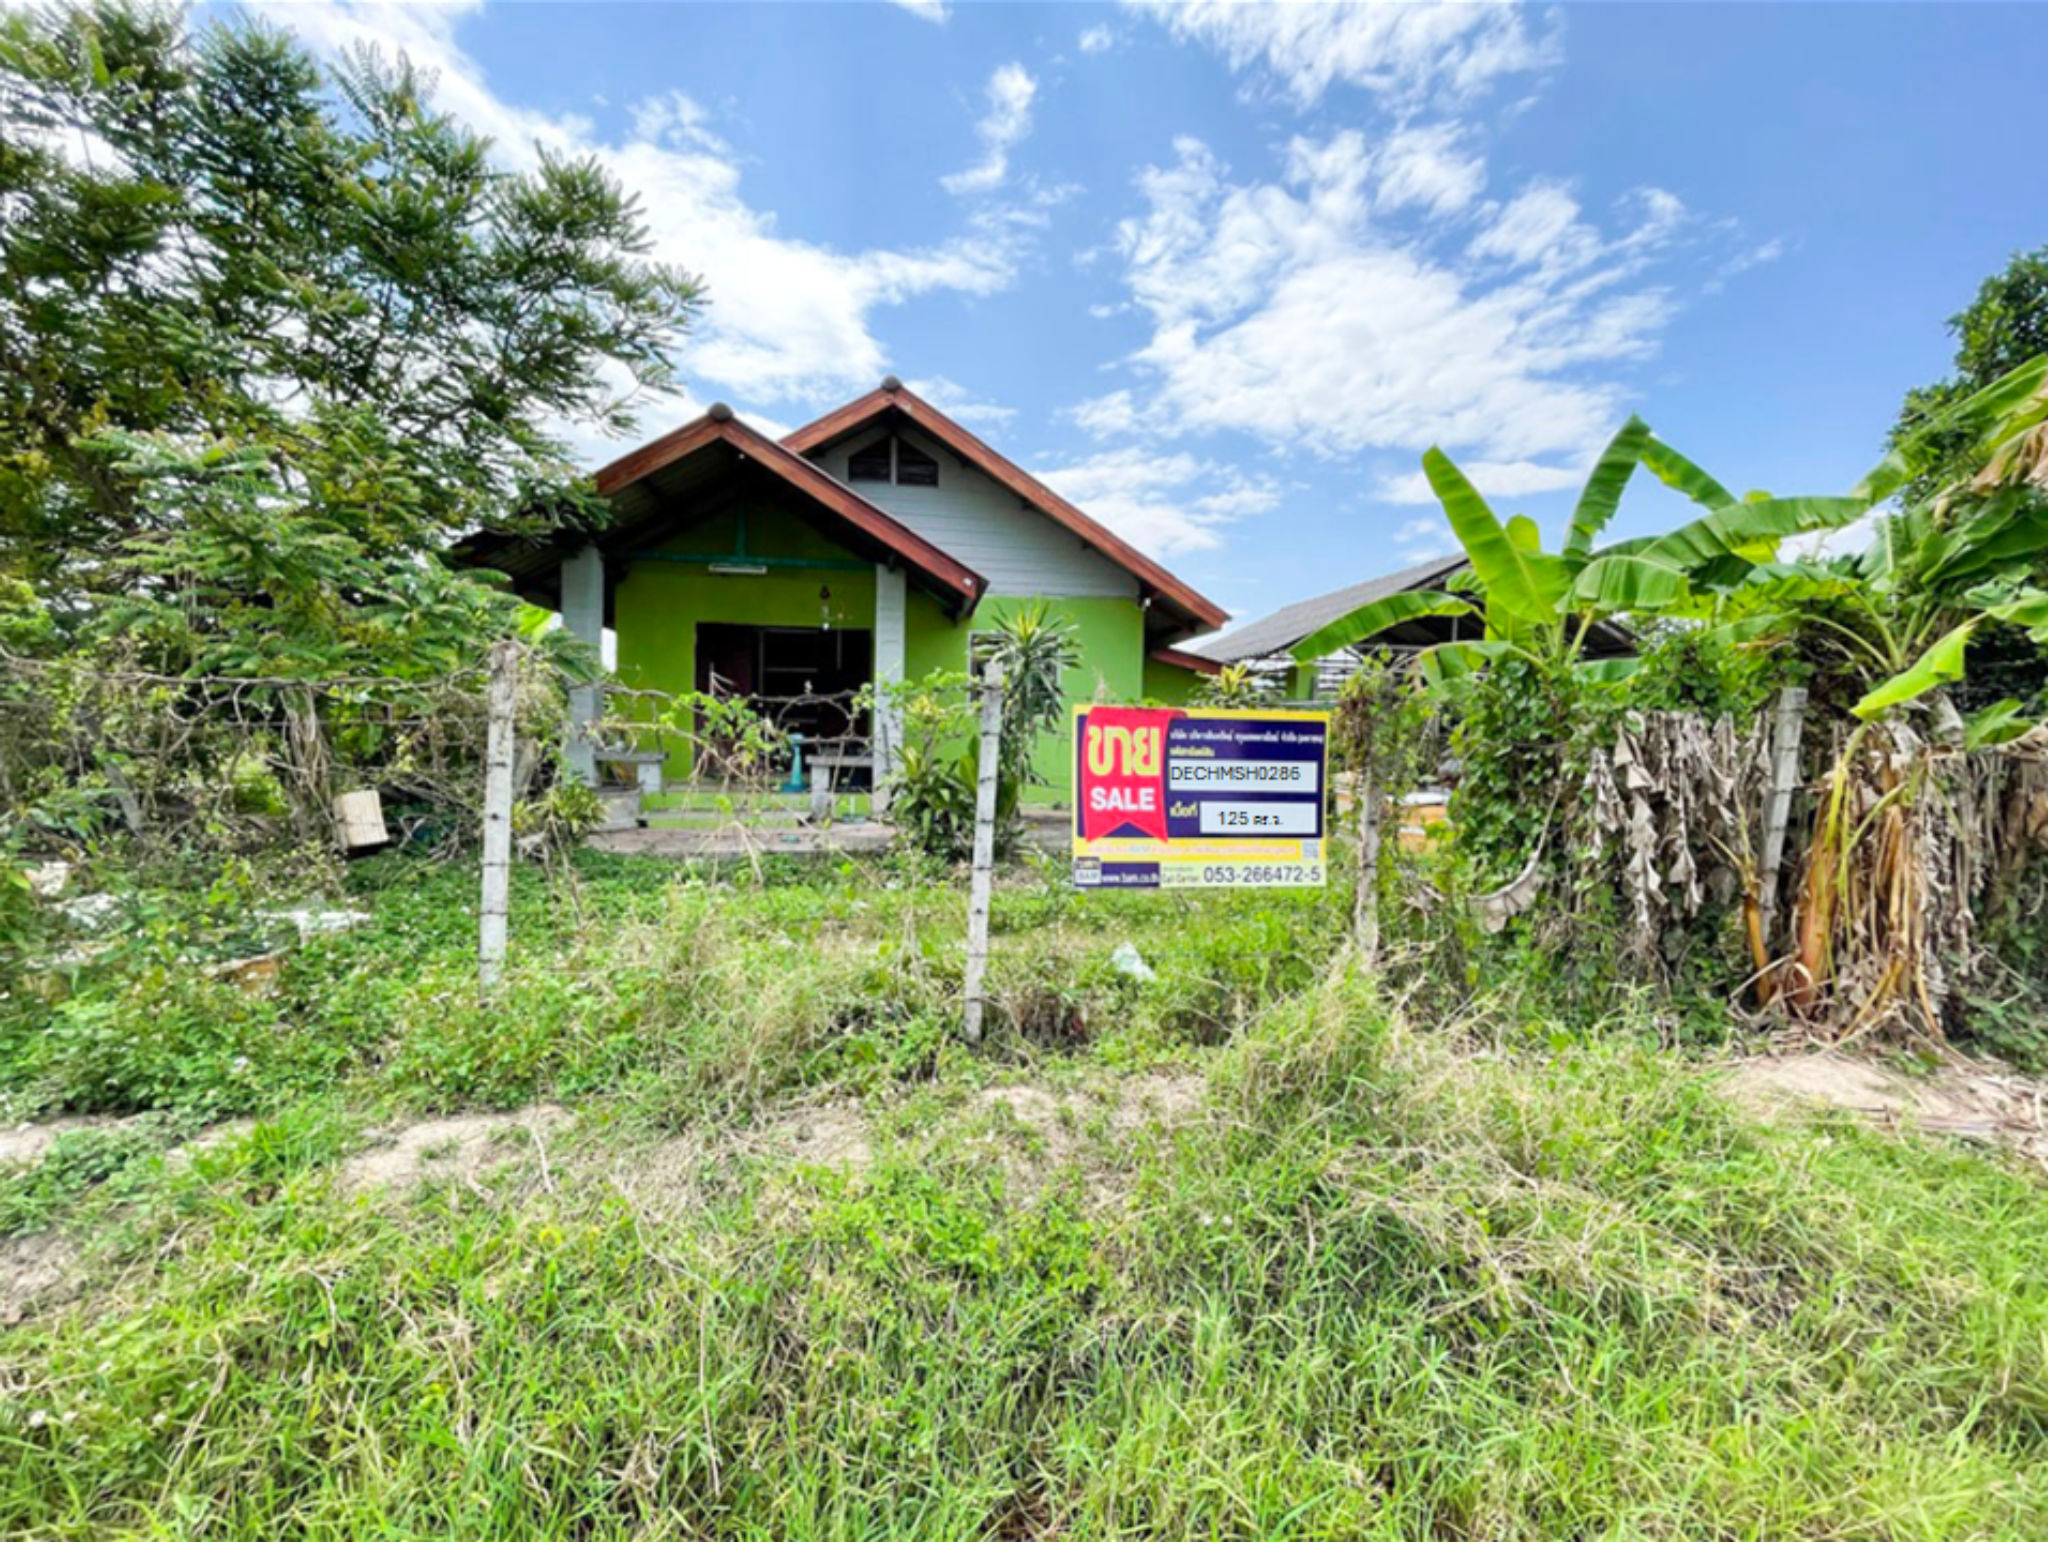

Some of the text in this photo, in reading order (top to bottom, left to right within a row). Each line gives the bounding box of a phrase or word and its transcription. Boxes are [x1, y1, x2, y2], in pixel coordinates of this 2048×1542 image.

[1088, 725, 1161, 776] ขาย
[1170, 766, 1301, 781] DECHMSH0286
[1090, 787, 1156, 811] SALE
[1217, 810, 1249, 826] 125
[1203, 866, 1321, 884] 053-266472-5
